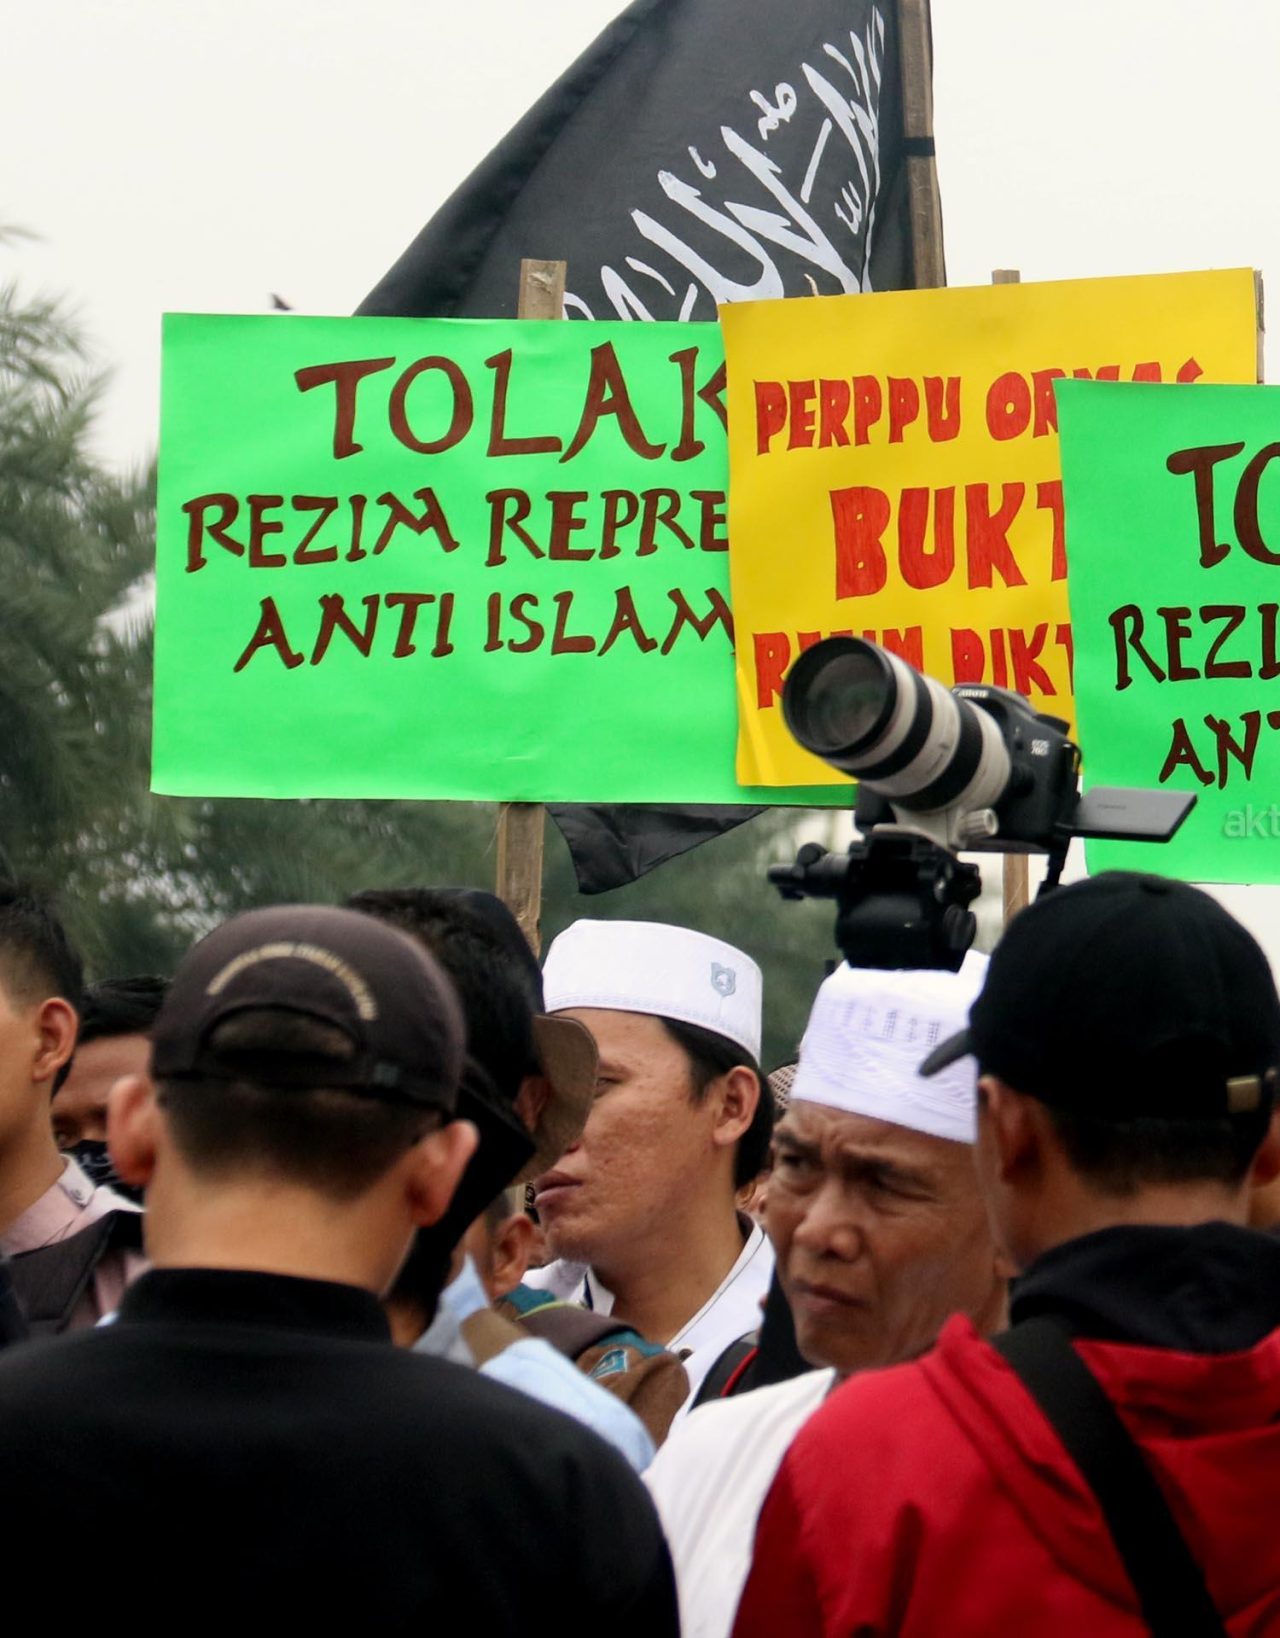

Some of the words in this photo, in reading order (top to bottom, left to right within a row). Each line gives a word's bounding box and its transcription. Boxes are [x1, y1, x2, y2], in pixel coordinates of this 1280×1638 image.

[295, 341, 729, 463] TOLAK
[755, 375, 961, 456] PERPPU
[182, 487, 459, 573] REZIM
[234, 593, 454, 672] ANTI
[484, 586, 735, 656] ISLAM
